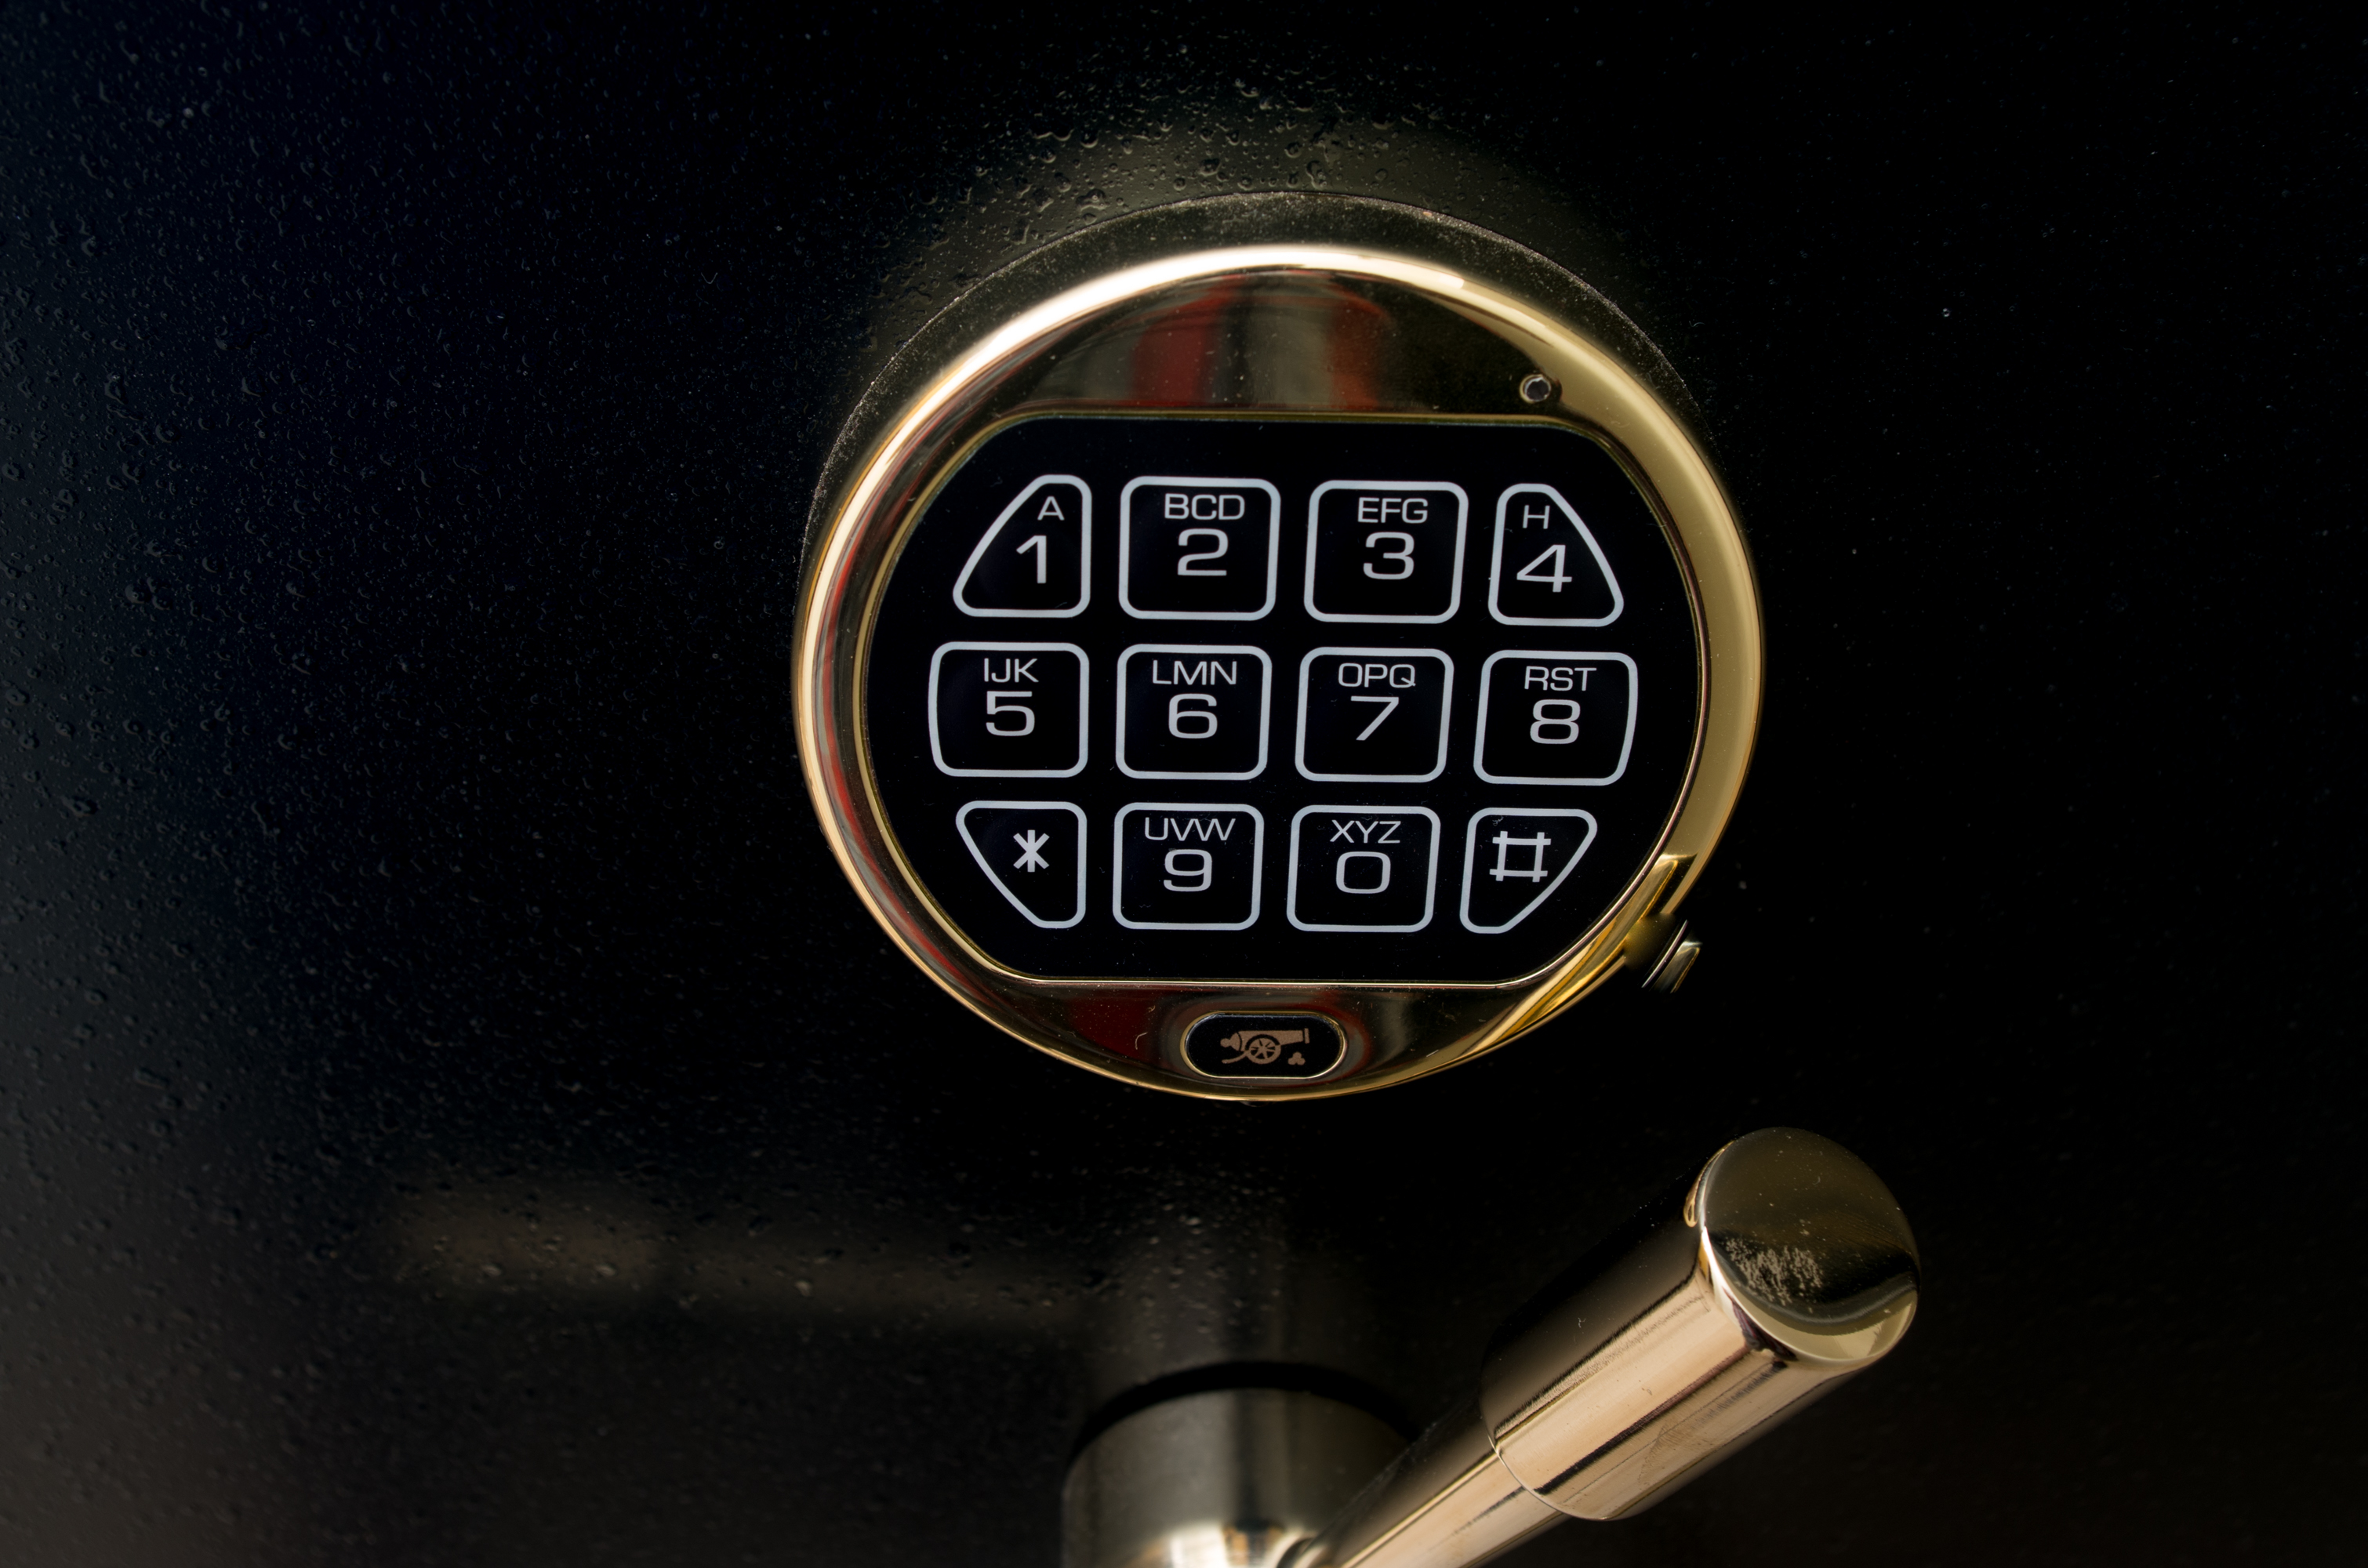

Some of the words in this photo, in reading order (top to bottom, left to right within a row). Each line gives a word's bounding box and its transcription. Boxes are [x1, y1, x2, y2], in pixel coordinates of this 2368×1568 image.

[1037, 496, 1065, 521] A
[1164, 493, 1245, 521] BCD
[1357, 497, 1428, 524] EFG
[1523, 505, 1550, 529] H
[1016, 535, 1047, 584] 1
[1177, 528, 1229, 576] 2
[1363, 532, 1415, 580] 3
[1516, 544, 1572, 593] 4
[984, 658, 1039, 683] IJK
[1152, 659, 1237, 685] LMN
[1338, 662, 1416, 688] OPQ
[1524, 666, 1597, 691] RST
[986, 691, 1035, 736] 5
[1168, 693, 1218, 739] 6
[1350, 695, 1400, 741] 7
[1530, 699, 1581, 745] 8
[1144, 817, 1236, 841] UVW
[1330, 819, 1401, 844] XYZ
[1163, 848, 1213, 892] 9
[1335, 851, 1391, 895] 0
[1489, 830, 1552, 883] #
